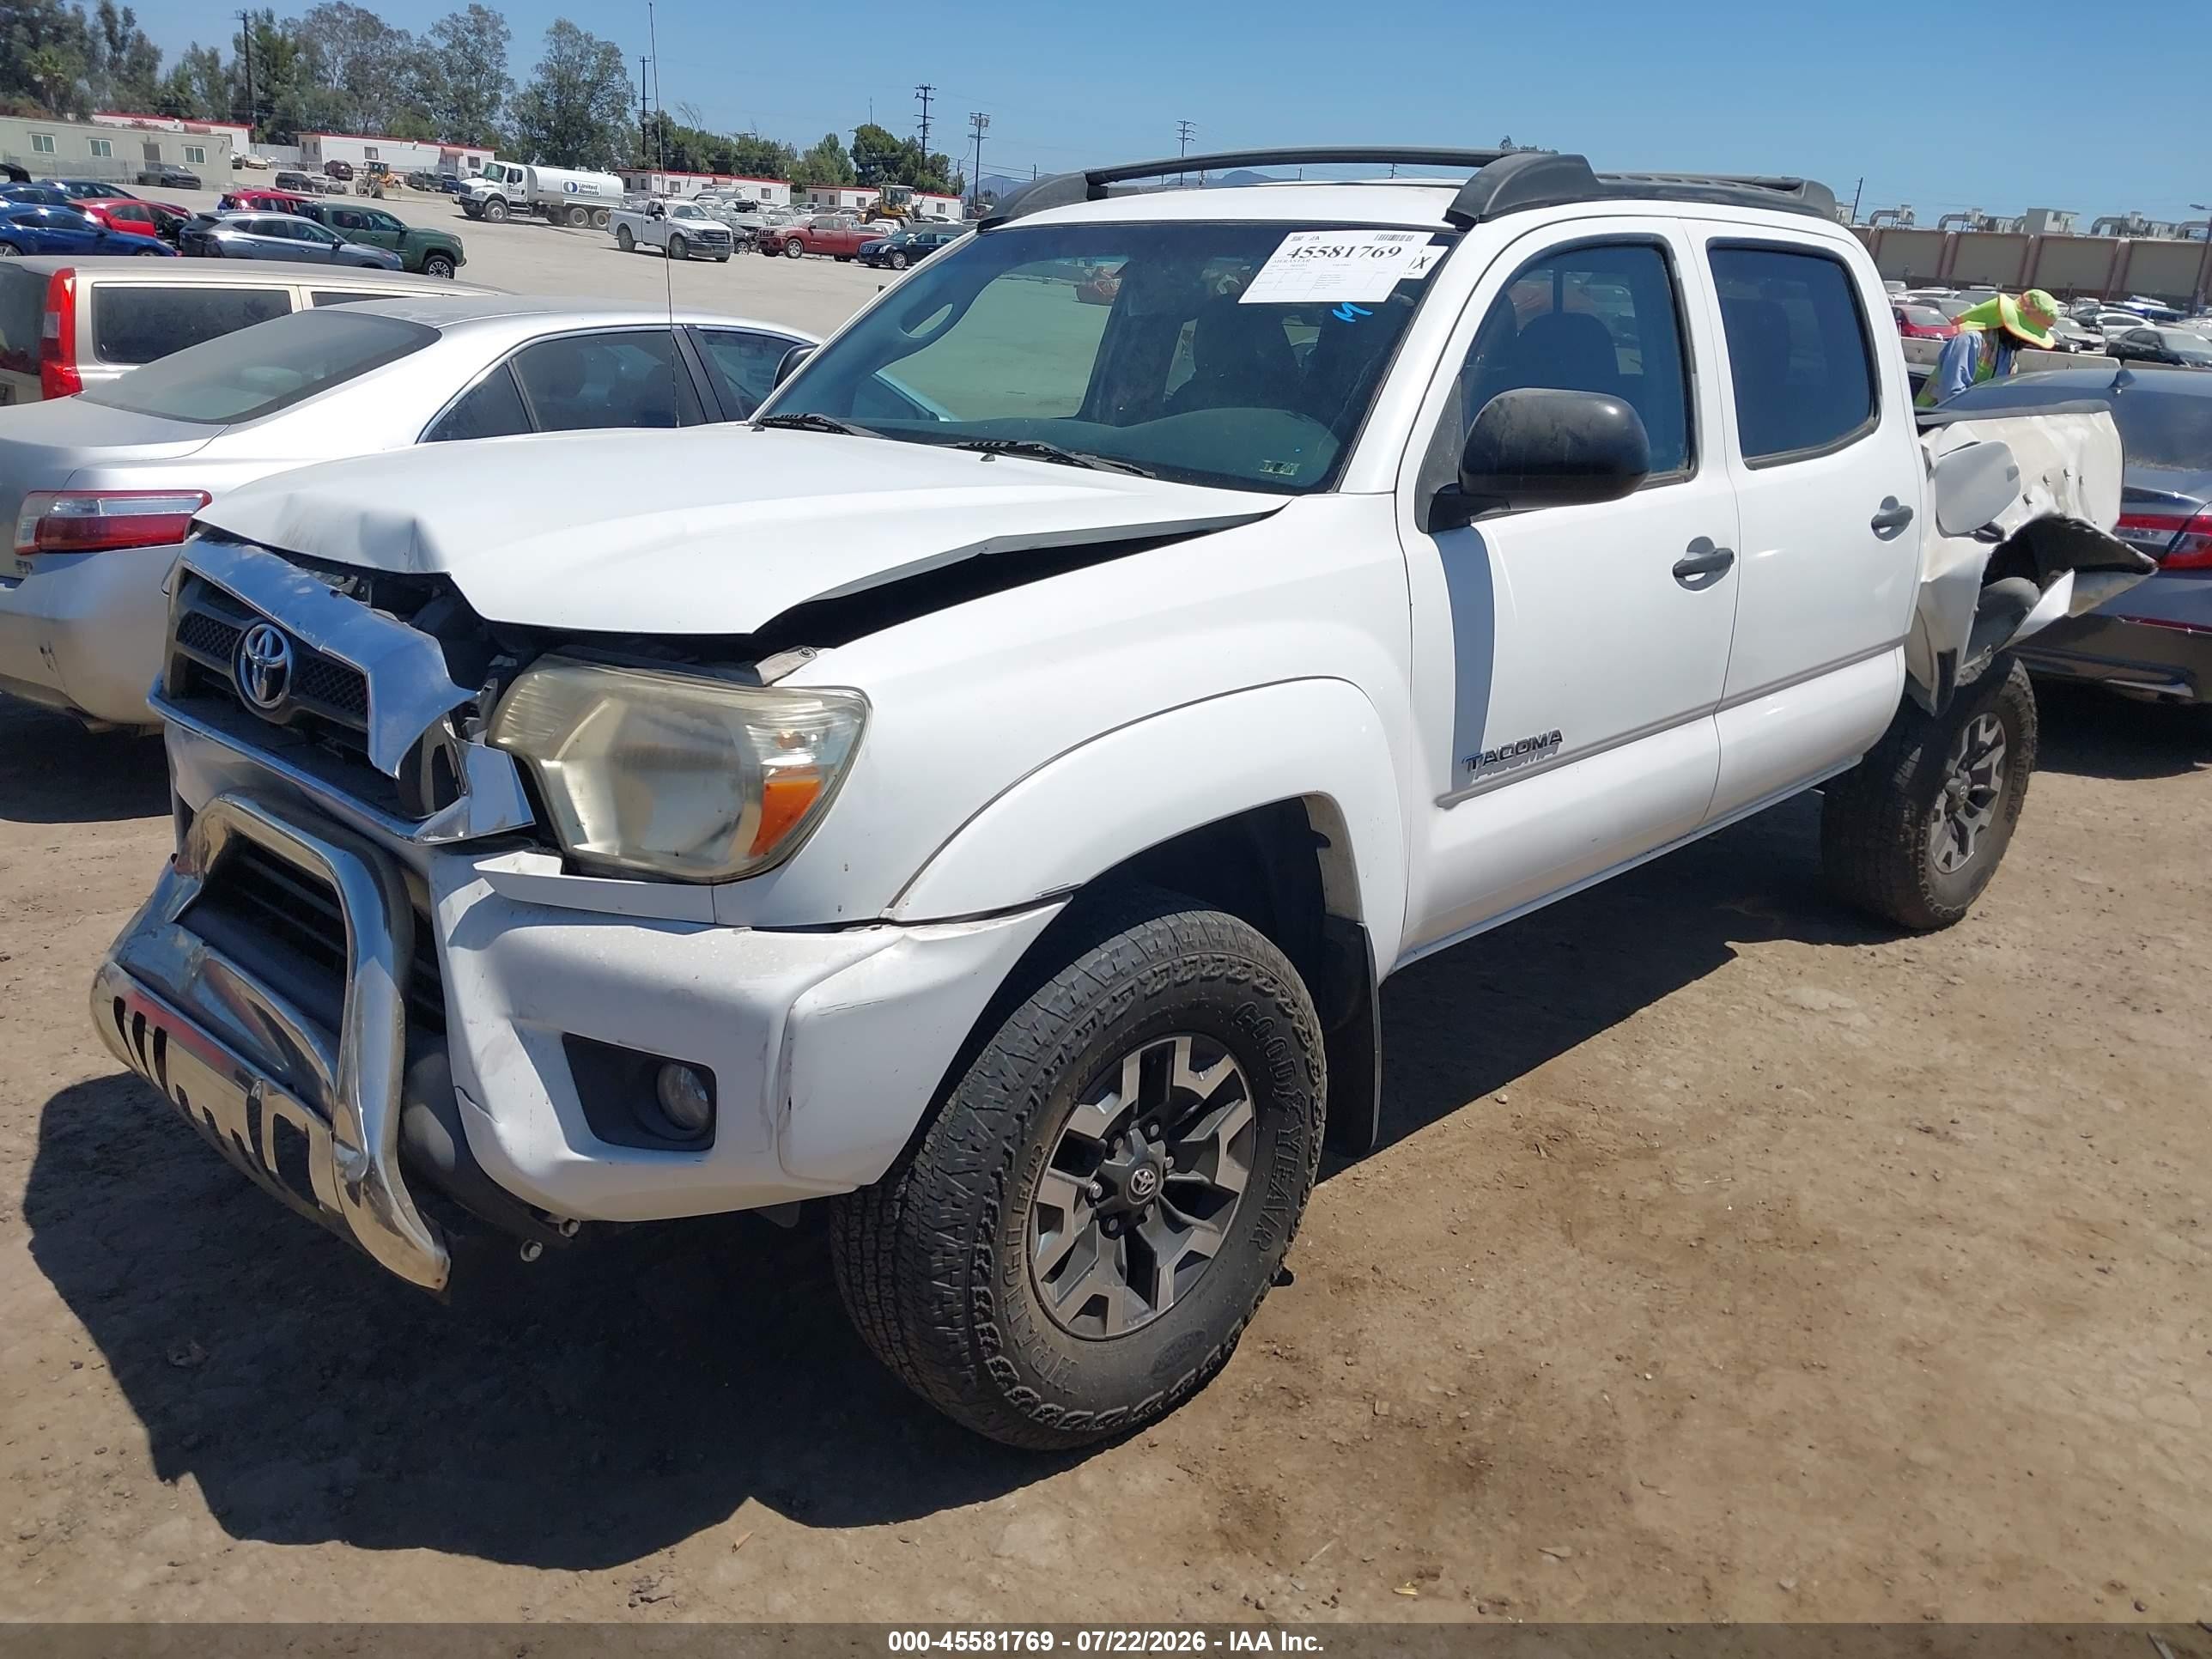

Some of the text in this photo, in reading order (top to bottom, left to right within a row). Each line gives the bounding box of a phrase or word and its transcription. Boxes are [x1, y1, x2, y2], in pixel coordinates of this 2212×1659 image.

[1286, 245, 1402, 258] 45581769
[1462, 729, 1564, 772] TACOMA
[1232, 1000, 1307, 1252] GOODYEAR
[1003, 1144, 1079, 1395] WRANGLER
